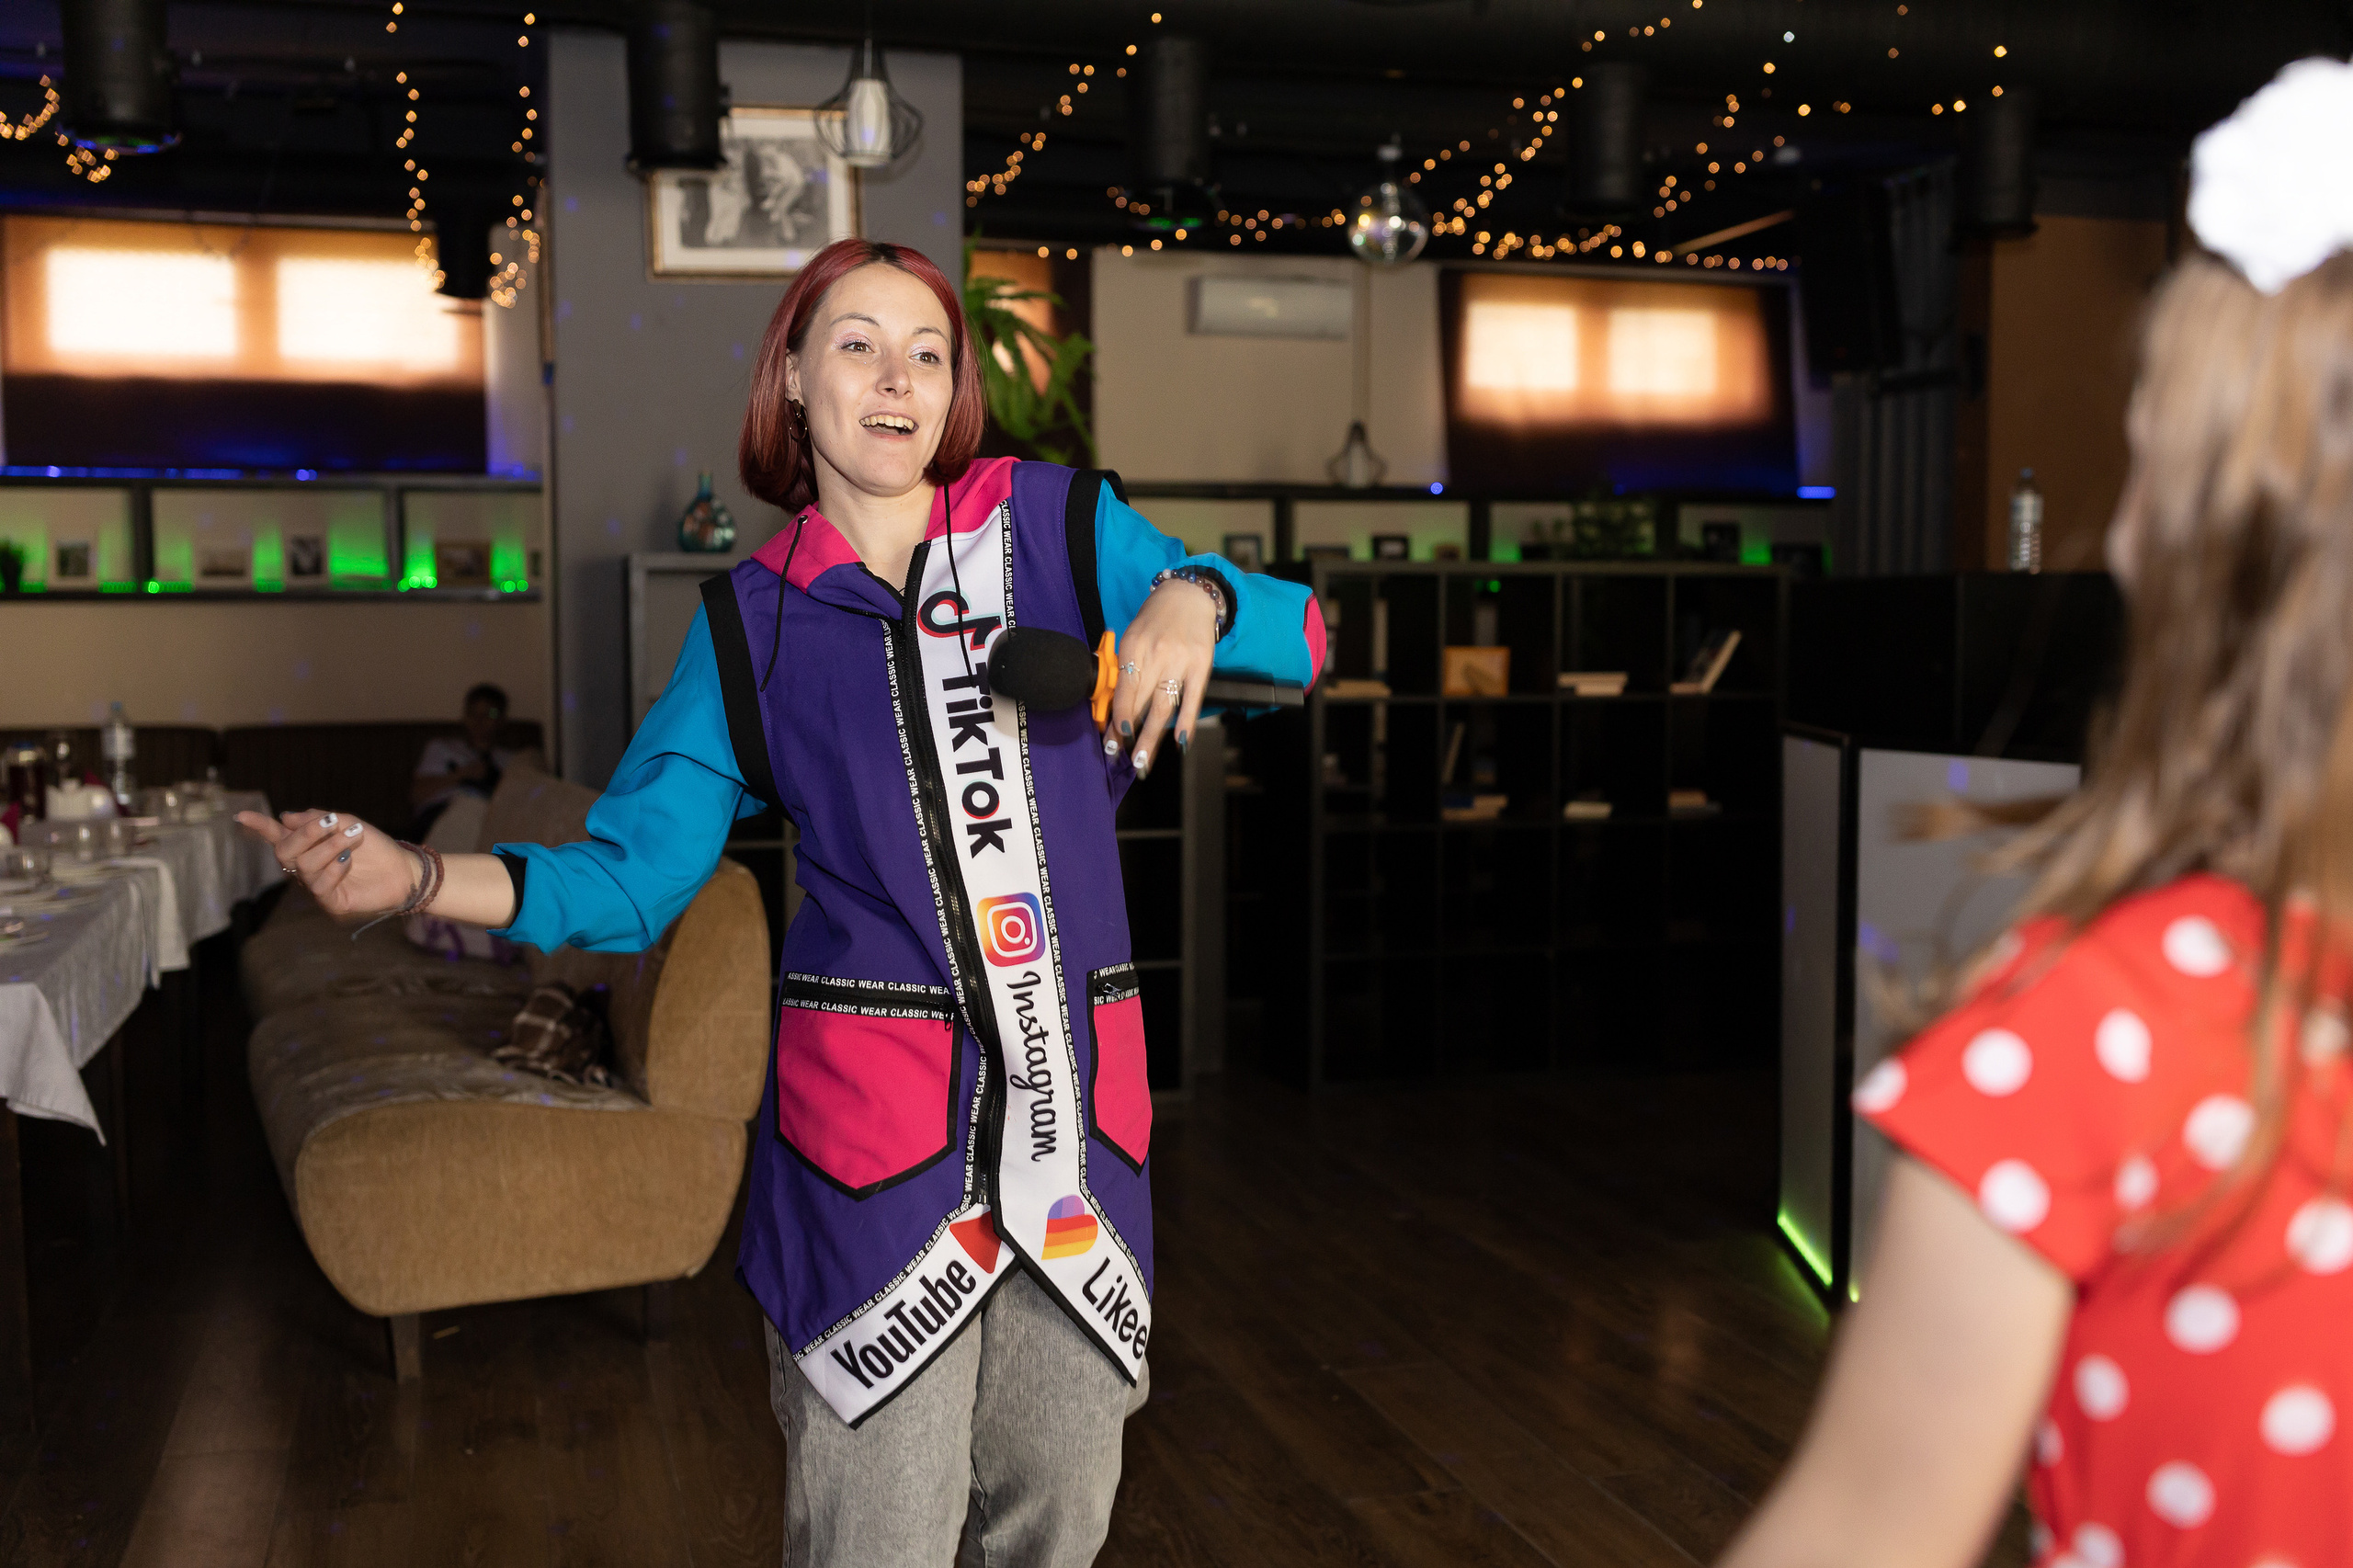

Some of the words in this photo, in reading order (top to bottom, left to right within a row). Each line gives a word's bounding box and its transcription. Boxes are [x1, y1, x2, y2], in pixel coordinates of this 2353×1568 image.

[1000, 499, 1010, 528] CLASSIC
[1003, 530, 1012, 554] WEAR
[1005, 556, 1013, 591] CLASSIC
[1006, 592, 1015, 618] WEAR
[884, 635, 894, 660] WEAR
[886, 660, 899, 698] CLASSIC
[892, 699, 904, 726] WEAR
[1018, 700, 1027, 727] ASSIC
[898, 728, 912, 767] CLASSIC
[1020, 728, 1029, 756] WEAR
[942, 661, 1013, 859] TikTok
[906, 767, 919, 798] WEAR
[1022, 757, 1035, 796] CLASSIC
[912, 798, 926, 837] CLASSIC
[1029, 797, 1040, 825] WEAR
[921, 838, 934, 867] WEAR
[1033, 827, 1046, 866] CLASSIC
[928, 868, 943, 907] CLASSIC
[1040, 866, 1051, 893] WEAR
[938, 908, 949, 937] WEAR
[1044, 895, 1057, 934] CLASSIC
[943, 937, 960, 976] CLASSIC
[1051, 935, 1061, 963] WEAR
[787, 972, 801, 981] ASSIC
[801, 974, 819, 983] WEAR
[821, 976, 855, 987] CLASSIC
[858, 980, 884, 991] WEAR
[888, 982, 926, 994] CLASSIC
[929, 985, 949, 994] WEA
[954, 978, 966, 1005] WEAR
[1055, 964, 1066, 1004] CLASSIC
[782, 997, 800, 1007] LASSIC
[800, 999, 819, 1009] WEAR
[821, 1002, 858, 1014] CLASSIC
[860, 1006, 887, 1017] WEAR
[890, 1007, 928, 1018] CLASSIC
[1061, 1004, 1070, 1031] WEAR
[1006, 971, 1057, 1163] Instagram
[1064, 1033, 1077, 1072] CLASSIC
[975, 1056, 987, 1095] CLASSIC
[1072, 1072, 1082, 1099] WEAR
[971, 1096, 982, 1123] WEAR
[1075, 1100, 1085, 1140] CLASSIC
[965, 1125, 977, 1162] CLASSIC
[964, 1164, 973, 1192] WEAR
[803, 1335, 825, 1355] WEAR
[824, 1314, 853, 1338] CLASSIC
[851, 1298, 875, 1319] WEAR
[874, 1271, 906, 1301] CLASSIC
[904, 1250, 926, 1274] WEAR
[925, 1218, 949, 1250] CLASSIC
[1082, 1256, 1148, 1360] Likee
[829, 1259, 976, 1390] YouTube
